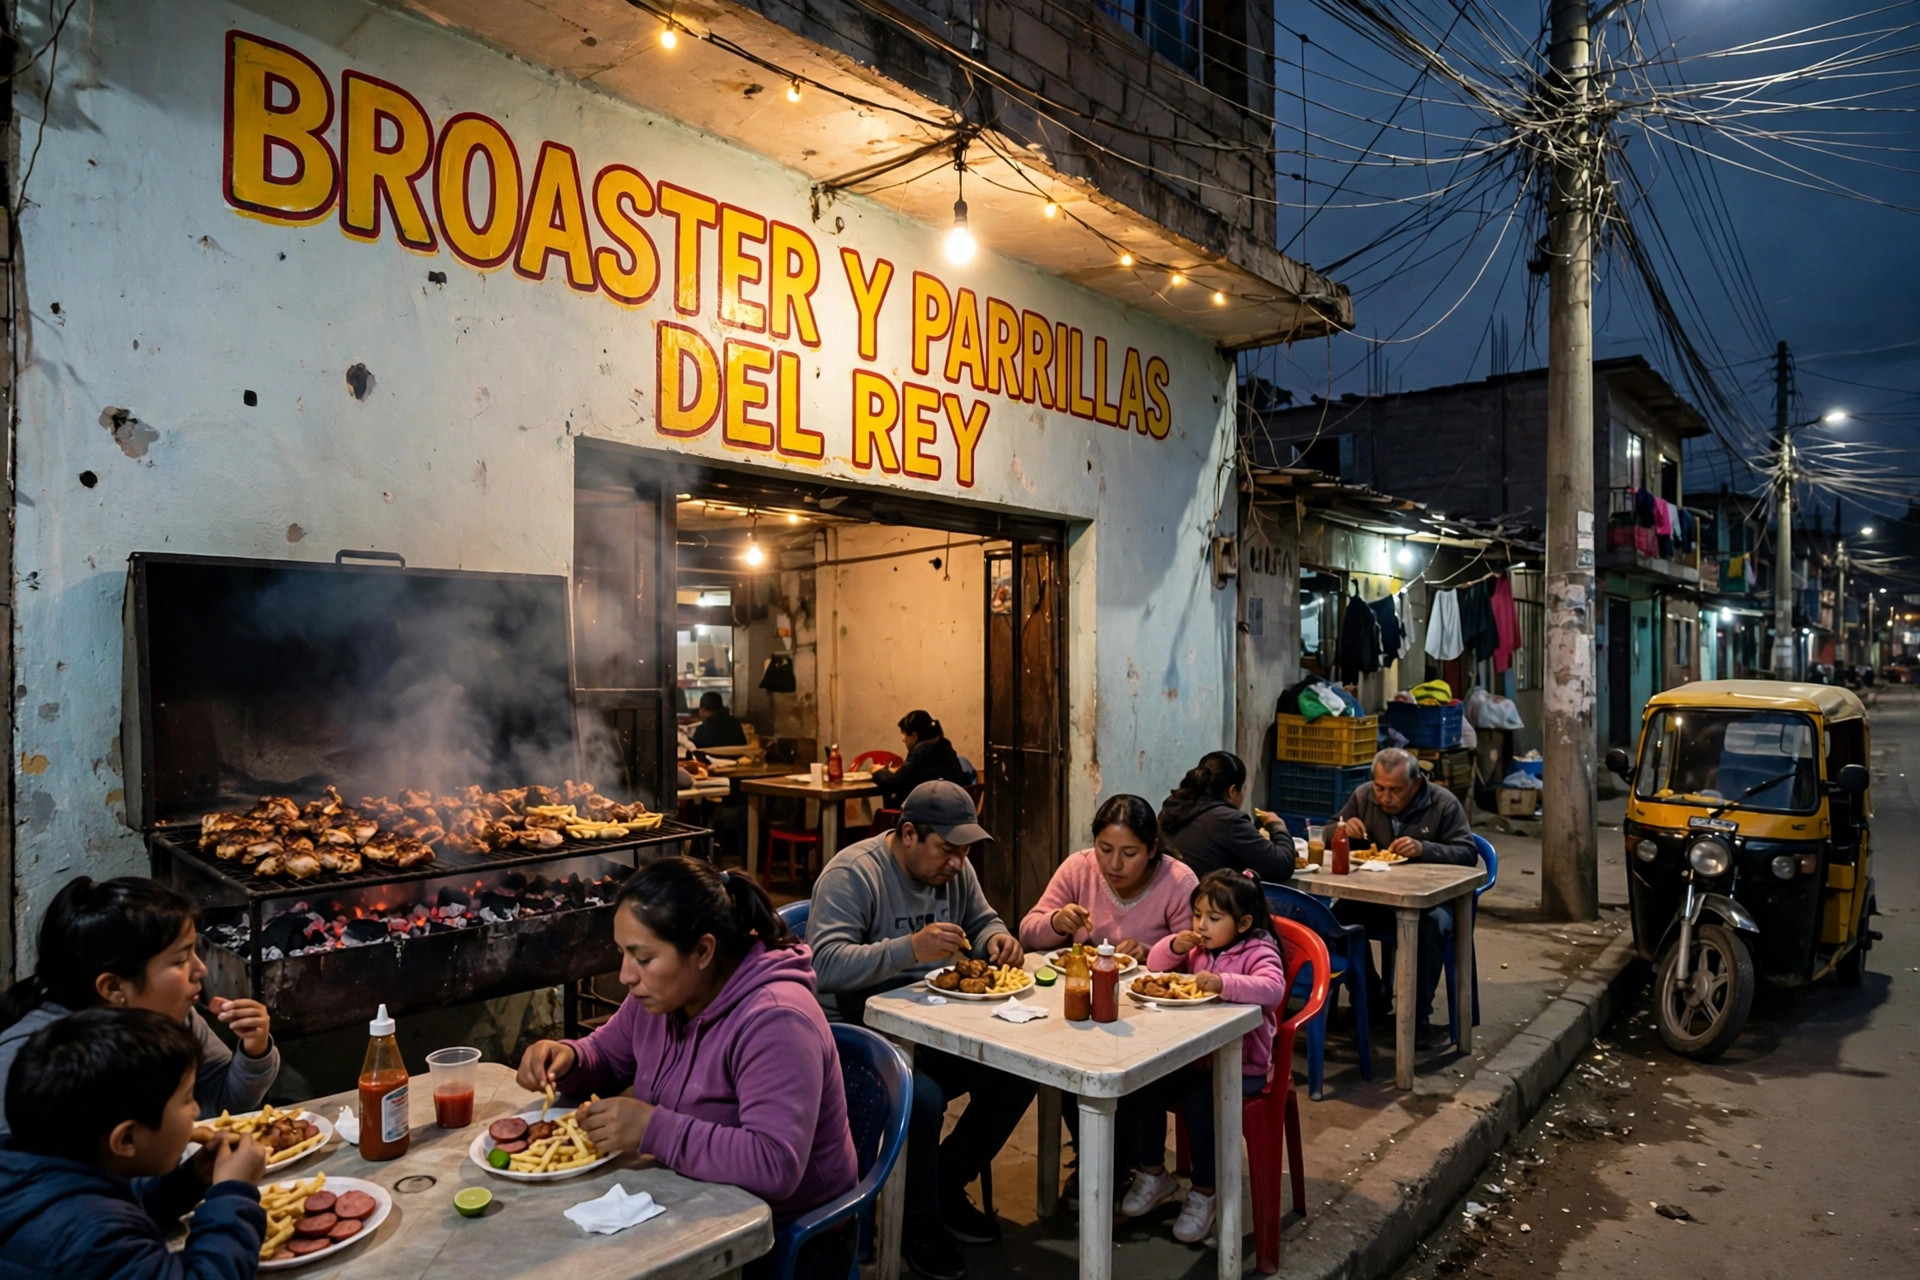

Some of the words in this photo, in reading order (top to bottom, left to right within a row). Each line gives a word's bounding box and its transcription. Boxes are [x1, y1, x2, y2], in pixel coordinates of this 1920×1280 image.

[223, 29, 820, 348] BROASTER
[840, 247, 894, 361] Y
[912, 270, 1171, 440] PARRILLAS
[655, 320, 825, 460] DEL
[851, 369, 990, 488] REY
